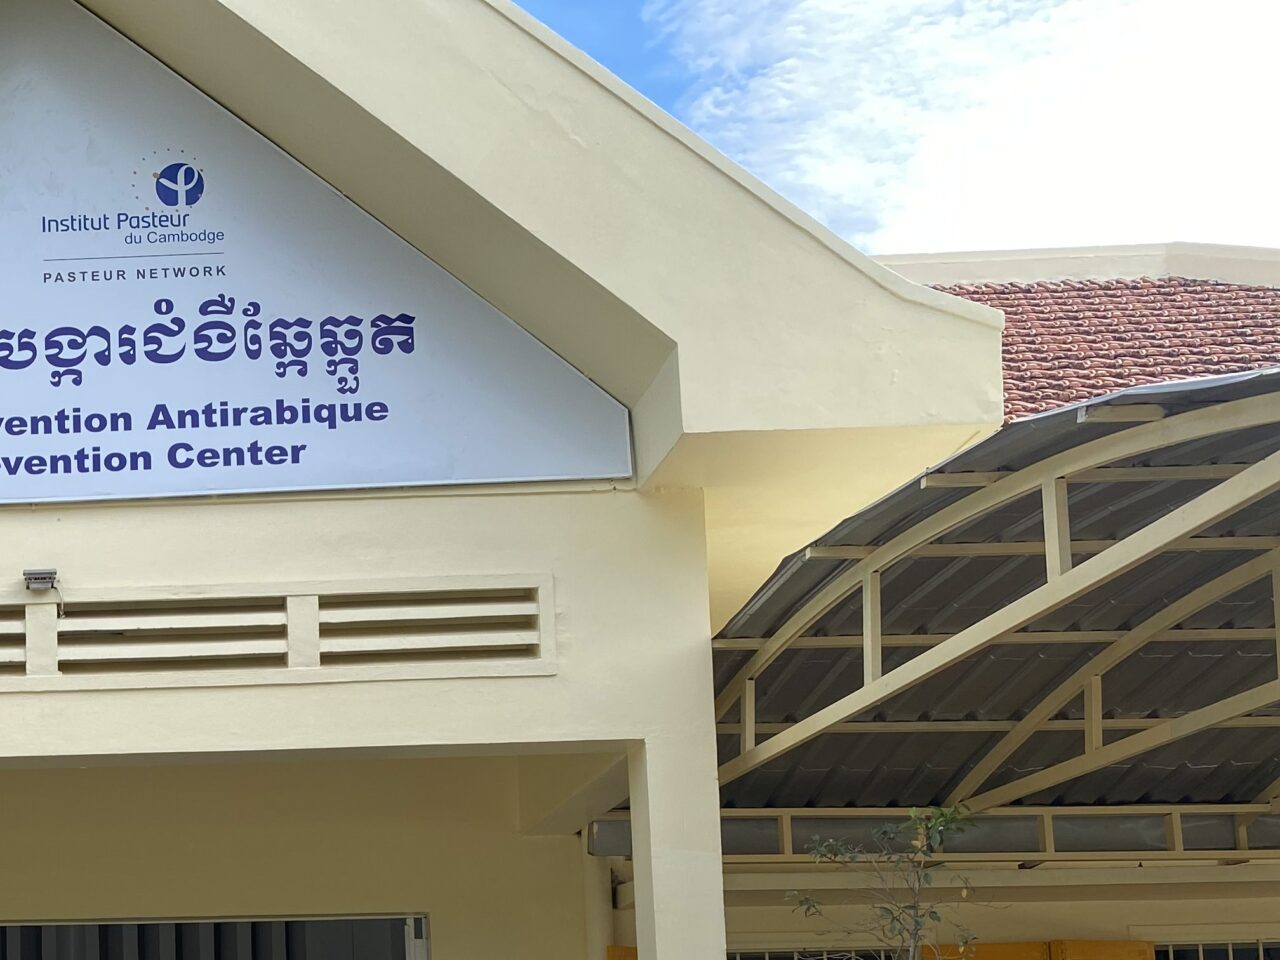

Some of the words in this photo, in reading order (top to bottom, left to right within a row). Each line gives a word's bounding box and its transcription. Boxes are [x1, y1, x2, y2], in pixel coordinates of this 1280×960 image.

[42, 214, 110, 233] Institut
[116, 212, 190, 230] Pasteur
[124, 233, 142, 245] du
[146, 230, 225, 245] Cambodge
[43, 270, 126, 284] PASTEUR
[136, 265, 226, 280] NETWORK
[146, 398, 389, 430] Antirabique
[167, 440, 307, 469] Center
